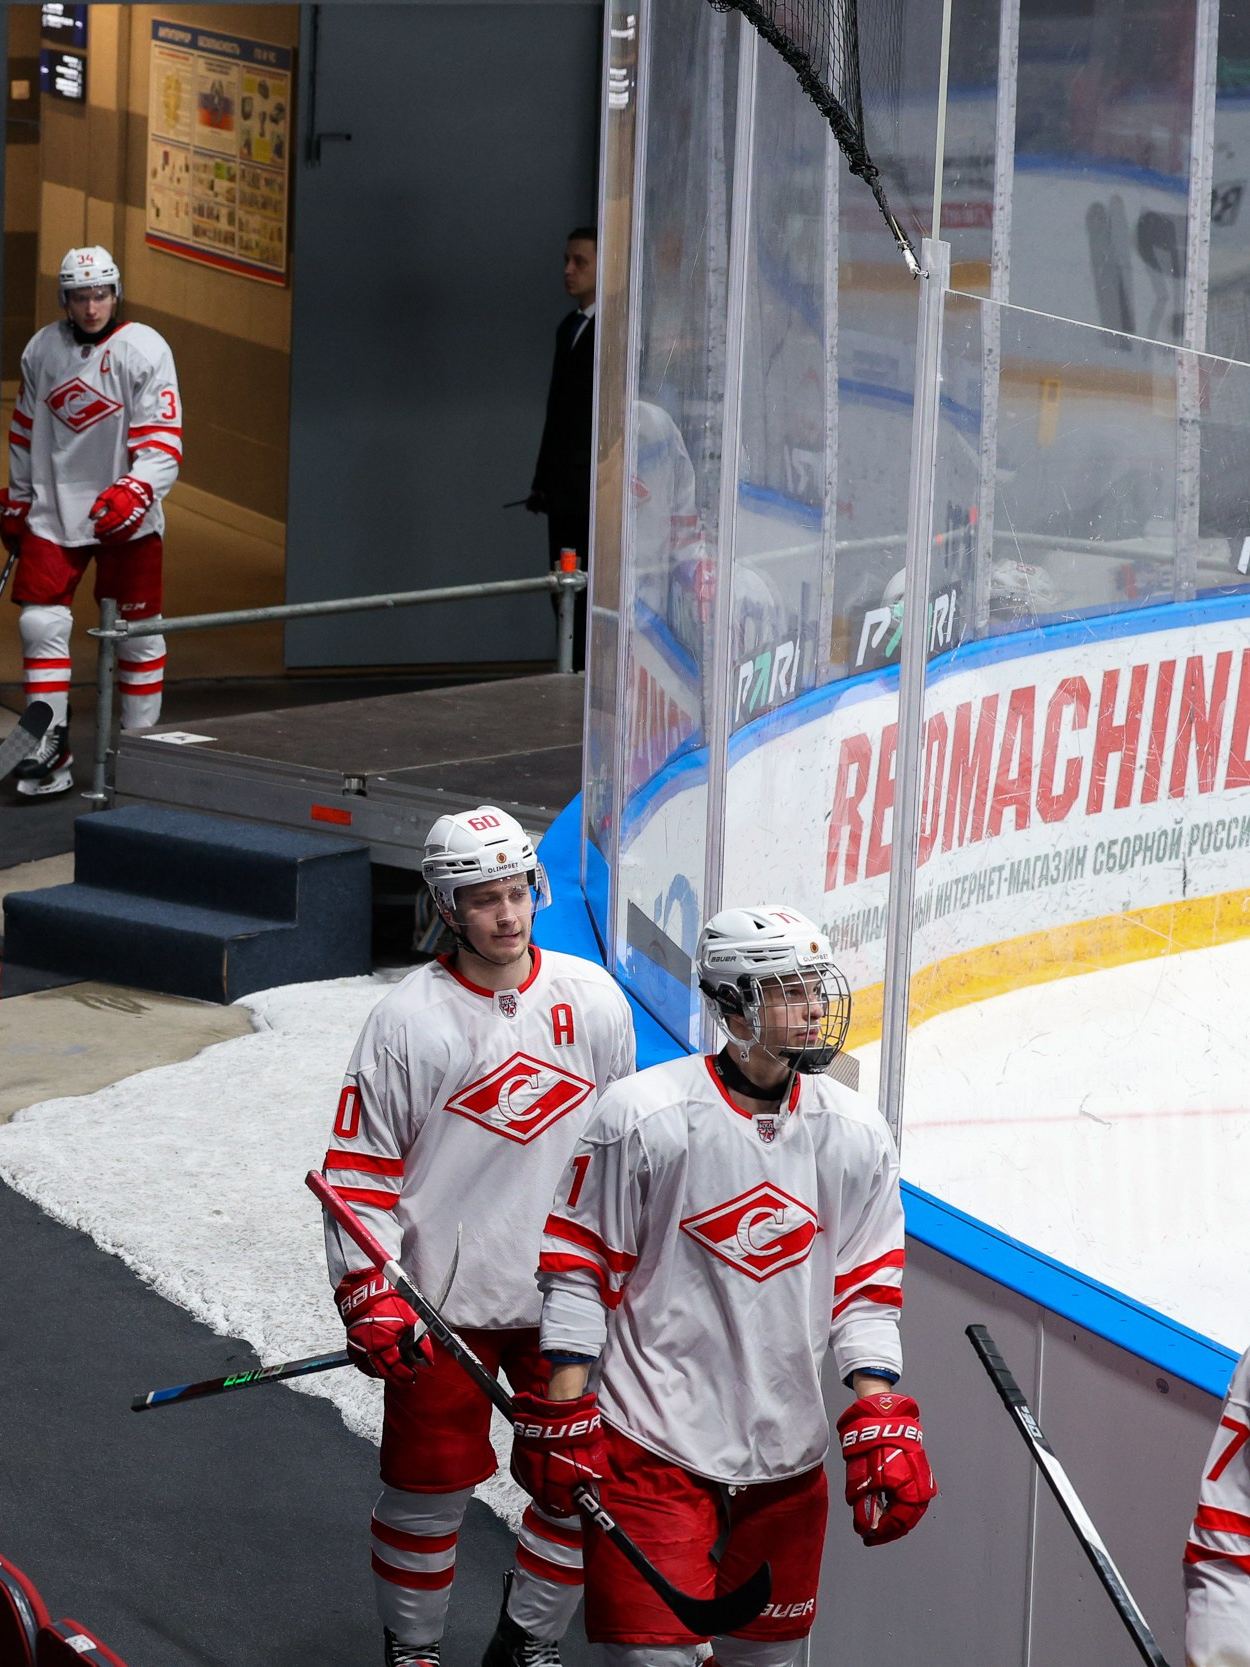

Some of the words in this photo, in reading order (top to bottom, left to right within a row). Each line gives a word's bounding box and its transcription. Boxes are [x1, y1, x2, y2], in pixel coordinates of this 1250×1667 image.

[76, 254, 94, 265] 34
[160, 390, 177, 420] 3
[735, 637, 800, 722] PARI
[467, 815, 501, 832] 60
[487, 862, 519, 874] OLIMPBET
[934, 844, 1088, 921] ИНТЕРНЕТ-МАГАЗИН
[1093, 817, 1184, 877] СБОРНОЙ
[803, 954, 829, 963] OLIMPBET
[551, 1002, 575, 1047] A
[333, 1085, 362, 1139] 0
[566, 1154, 591, 1209] 1
[513, 1414, 602, 1440] BAUER
[842, 1423, 923, 1448] BAUER
[1205, 1414, 1250, 1482] 7
[760, 1598, 814, 1618] AUER
